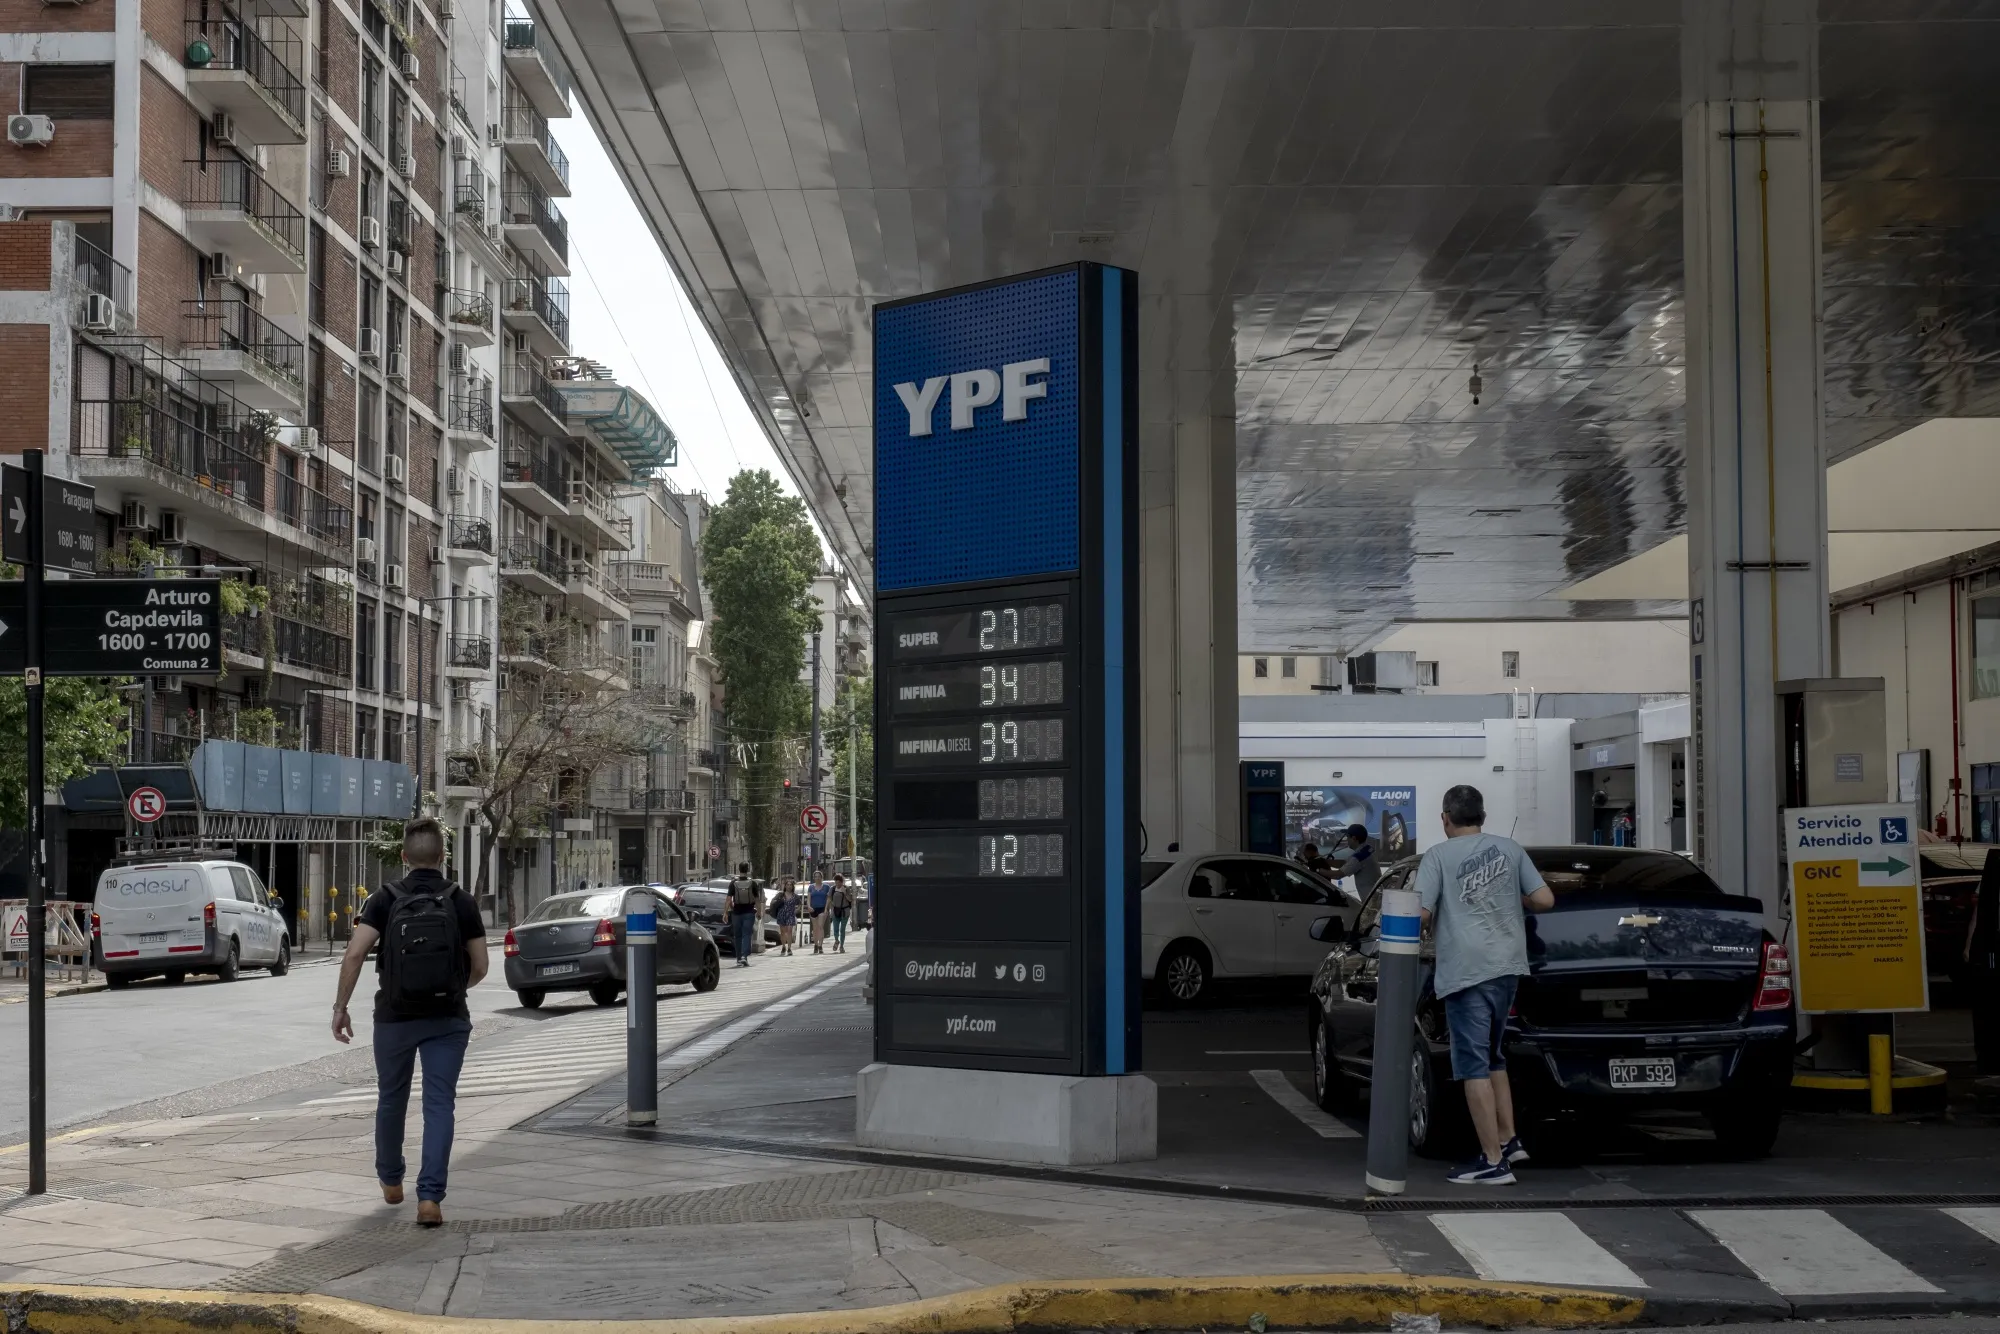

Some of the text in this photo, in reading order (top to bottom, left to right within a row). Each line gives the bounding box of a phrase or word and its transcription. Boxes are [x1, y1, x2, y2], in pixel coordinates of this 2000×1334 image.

[893, 357, 1050, 437] YPF
[62, 487, 93, 514] Paraguay
[57, 529, 73, 548] 1680
[78, 534, 94, 551] 1600
[71, 557, 93, 571] Comuna 2
[145, 588, 210, 605] Arturo
[105, 610, 203, 631] Capdevila
[980, 608, 1018, 650] 27
[1693, 602, 1703, 642] 6
[98, 633, 145, 650] 1600
[164, 632, 210, 650] 1700
[899, 632, 939, 648] SUPER
[143, 657, 209, 669] Comuna 2
[899, 684, 946, 701] INFINIA
[981, 666, 1018, 706] 34
[899, 737, 972, 755] INFINIA DIESEL
[981, 721, 1018, 762] 39
[1251, 769, 1277, 778] YPF
[1285, 791, 1324, 803] XES
[1370, 791, 1411, 800] ELAION
[1797, 814, 1862, 830] Servicio
[1798, 832, 1873, 848] Atendido
[899, 851, 924, 866] GNC
[990, 834, 1017, 875] 12
[1456, 845, 1501, 880] SANTA
[1462, 855, 1509, 893] CRUZ
[1804, 866, 1842, 880] GNC
[106, 879, 118, 890] 110
[119, 877, 190, 896] edesur
[1712, 945, 1745, 953] COBALT
[905, 960, 976, 980] @ypfoficial
[946, 1015, 996, 1034] ypf.com
[1612, 1065, 1673, 1082] PKP 592
